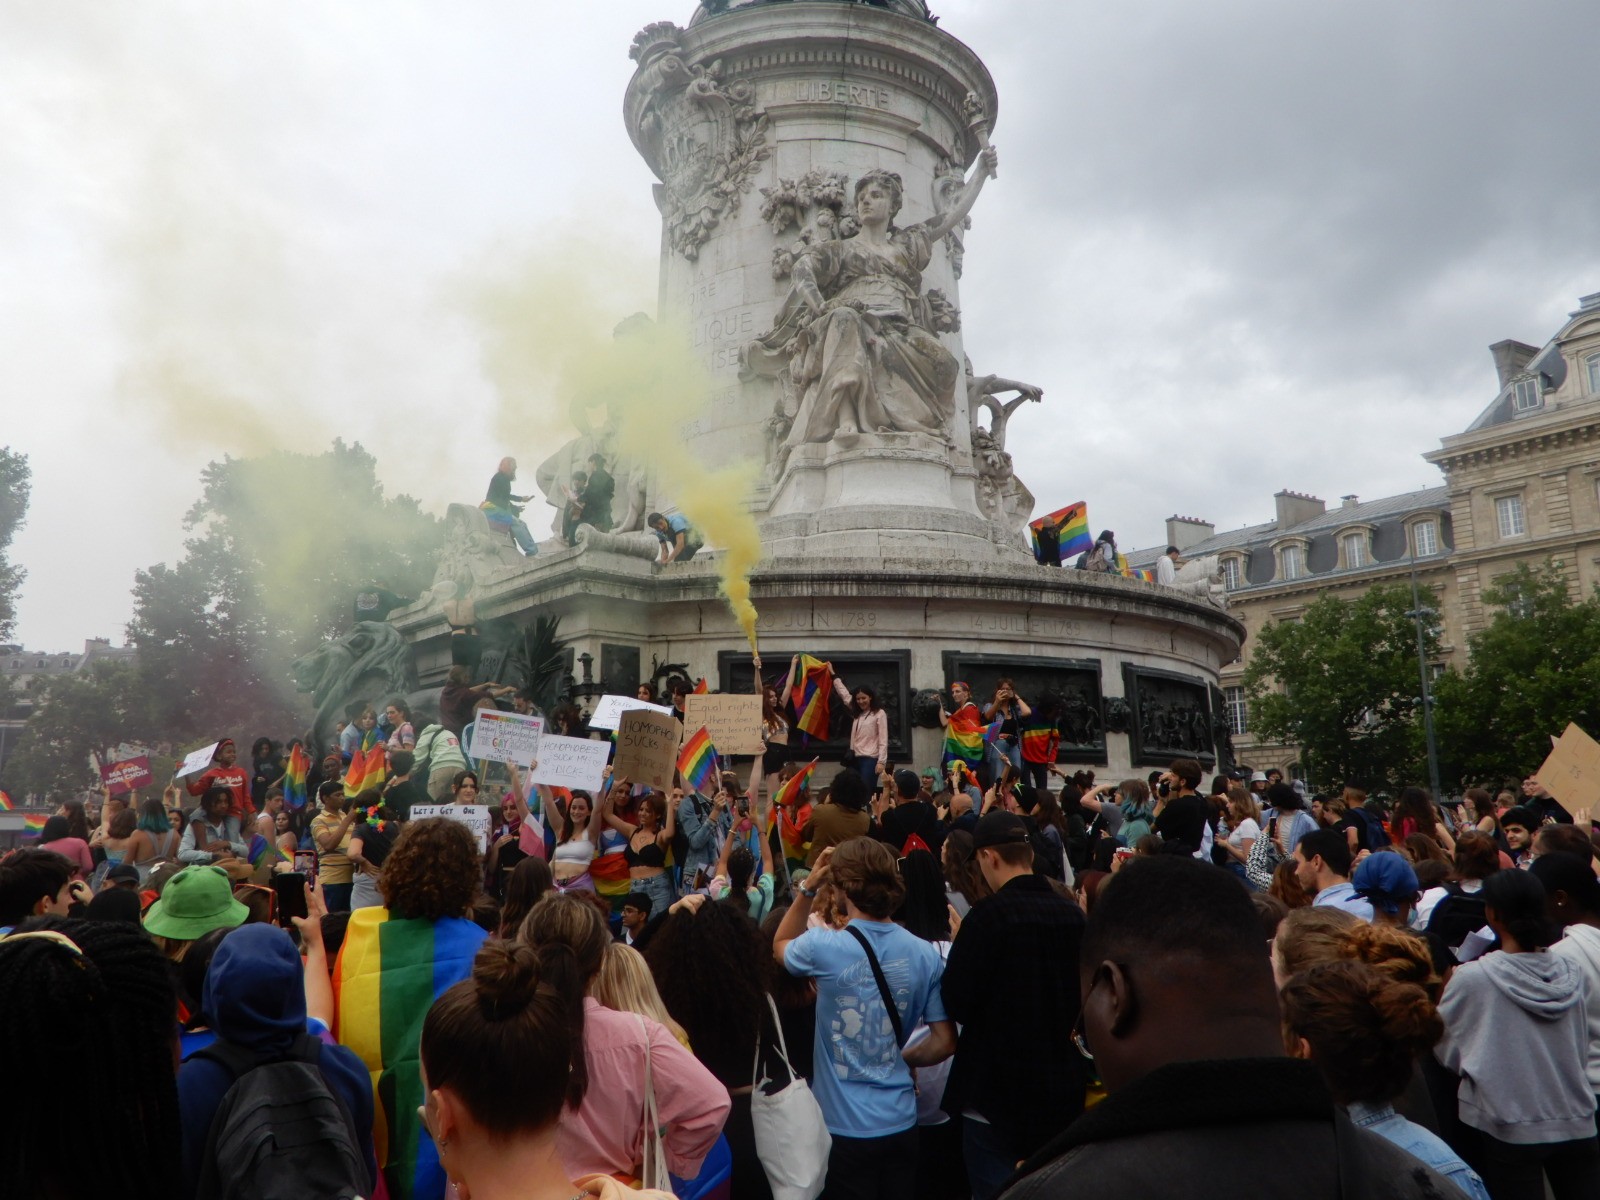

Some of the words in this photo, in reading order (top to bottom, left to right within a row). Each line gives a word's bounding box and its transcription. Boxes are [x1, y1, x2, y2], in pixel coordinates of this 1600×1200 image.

[841, 612, 877, 627] 1789
[970, 615, 983, 630] 14
[1054, 620, 1081, 636] 1789
[689, 698, 722, 718] Equal
[728, 701, 760, 715] rights
[553, 753, 573, 762] SUCK
[105, 775, 124, 785] MON
[124, 769, 149, 781] CHOIX
[109, 770, 122, 778] MA
[555, 764, 578, 775] DICK
